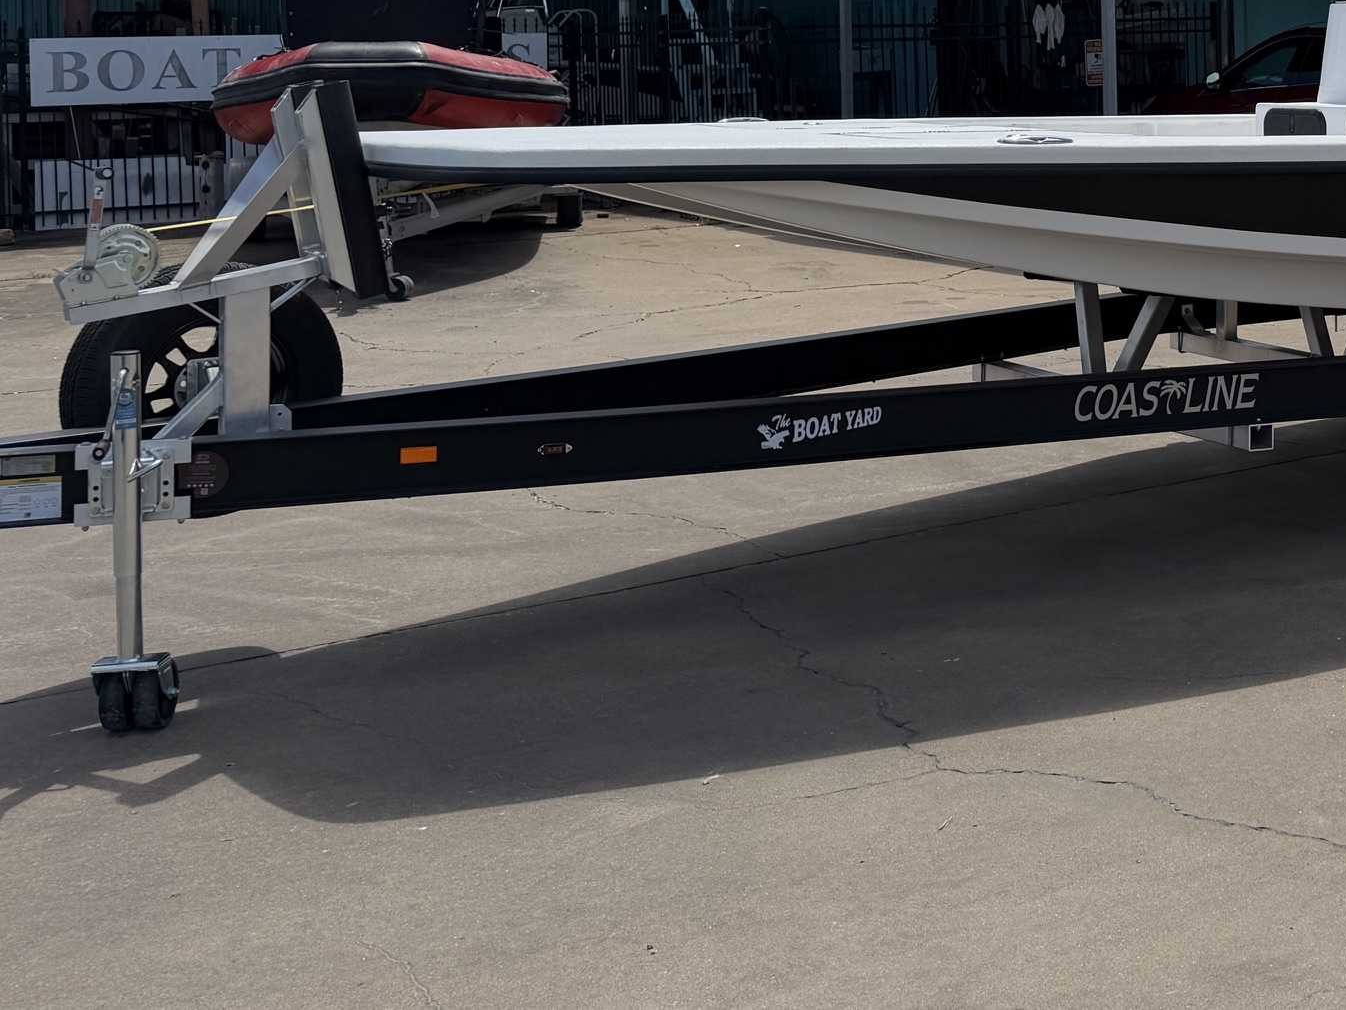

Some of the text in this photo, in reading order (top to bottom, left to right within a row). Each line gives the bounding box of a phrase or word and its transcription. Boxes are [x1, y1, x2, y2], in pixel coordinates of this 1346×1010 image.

[46, 48, 241, 94] BOAT
[771, 406, 882, 443] The BOAT YARD
